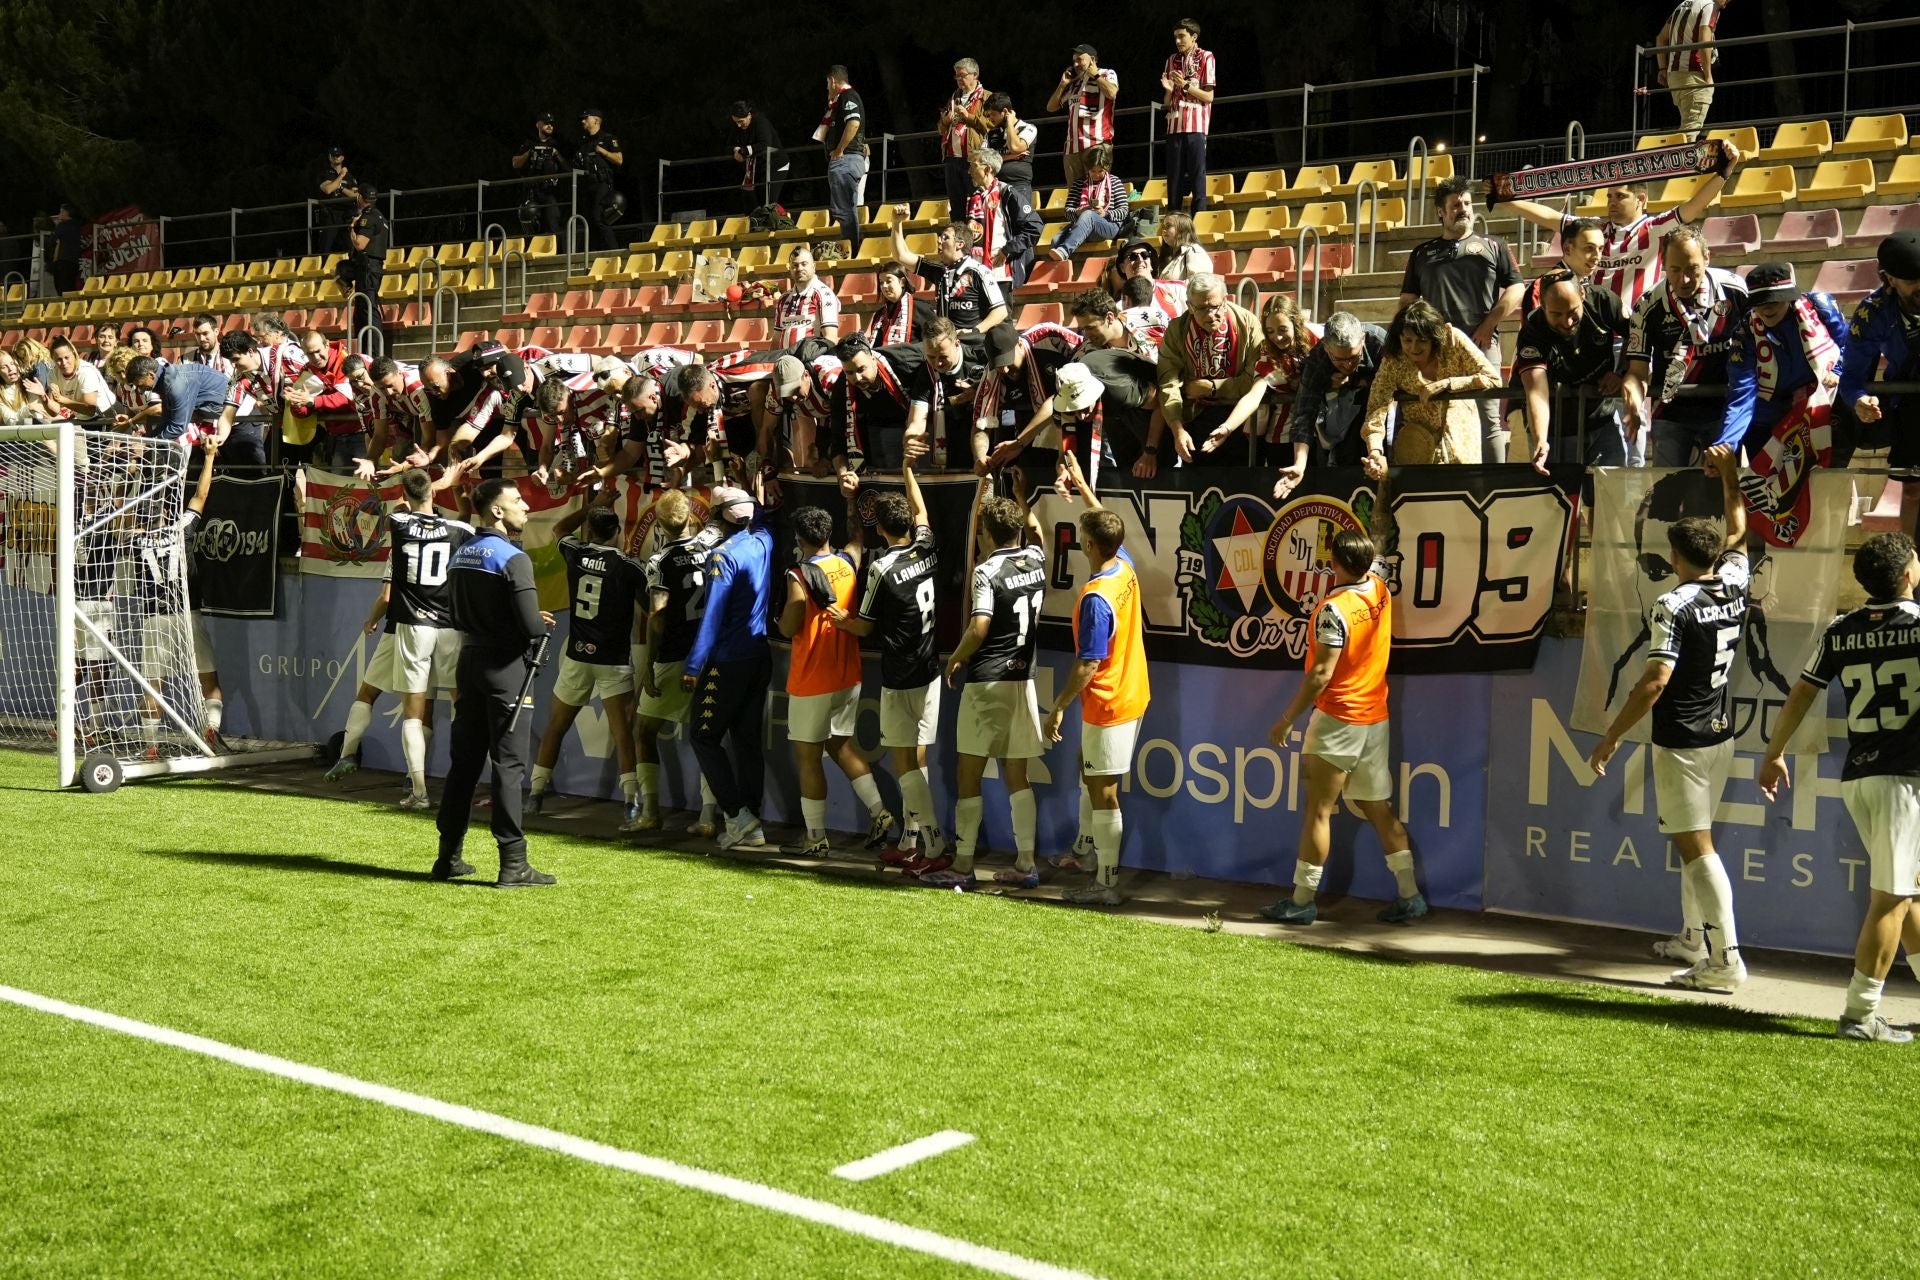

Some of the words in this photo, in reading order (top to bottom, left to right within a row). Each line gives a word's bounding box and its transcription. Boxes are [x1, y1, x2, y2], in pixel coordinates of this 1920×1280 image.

[1509, 148, 1698, 193] LOGROENFERMOS
[408, 523, 449, 539] ÁLVARO
[631, 511, 654, 558] OCIEDAD
[1266, 516, 1293, 560] SOCIEDAD
[1293, 505, 1343, 521] DEPORTIVA
[1289, 528, 1315, 571] SDL
[401, 541, 451, 586] 10
[581, 557, 607, 572] RAÚL
[893, 553, 938, 584] LAMADRID
[1187, 557, 1203, 573] 19
[1233, 547, 1257, 573] CDL
[1390, 485, 1573, 648] 09
[575, 574, 603, 620] 9
[915, 577, 935, 635] 8
[1012, 589, 1044, 647] 11
[258, 654, 341, 680] GRUPO
[1710, 624, 1741, 690] 5
[1841, 656, 1920, 733] 23
[1121, 731, 1451, 828] ospin
[1525, 826, 1684, 874] REAL
[1743, 848, 1867, 892] EST
